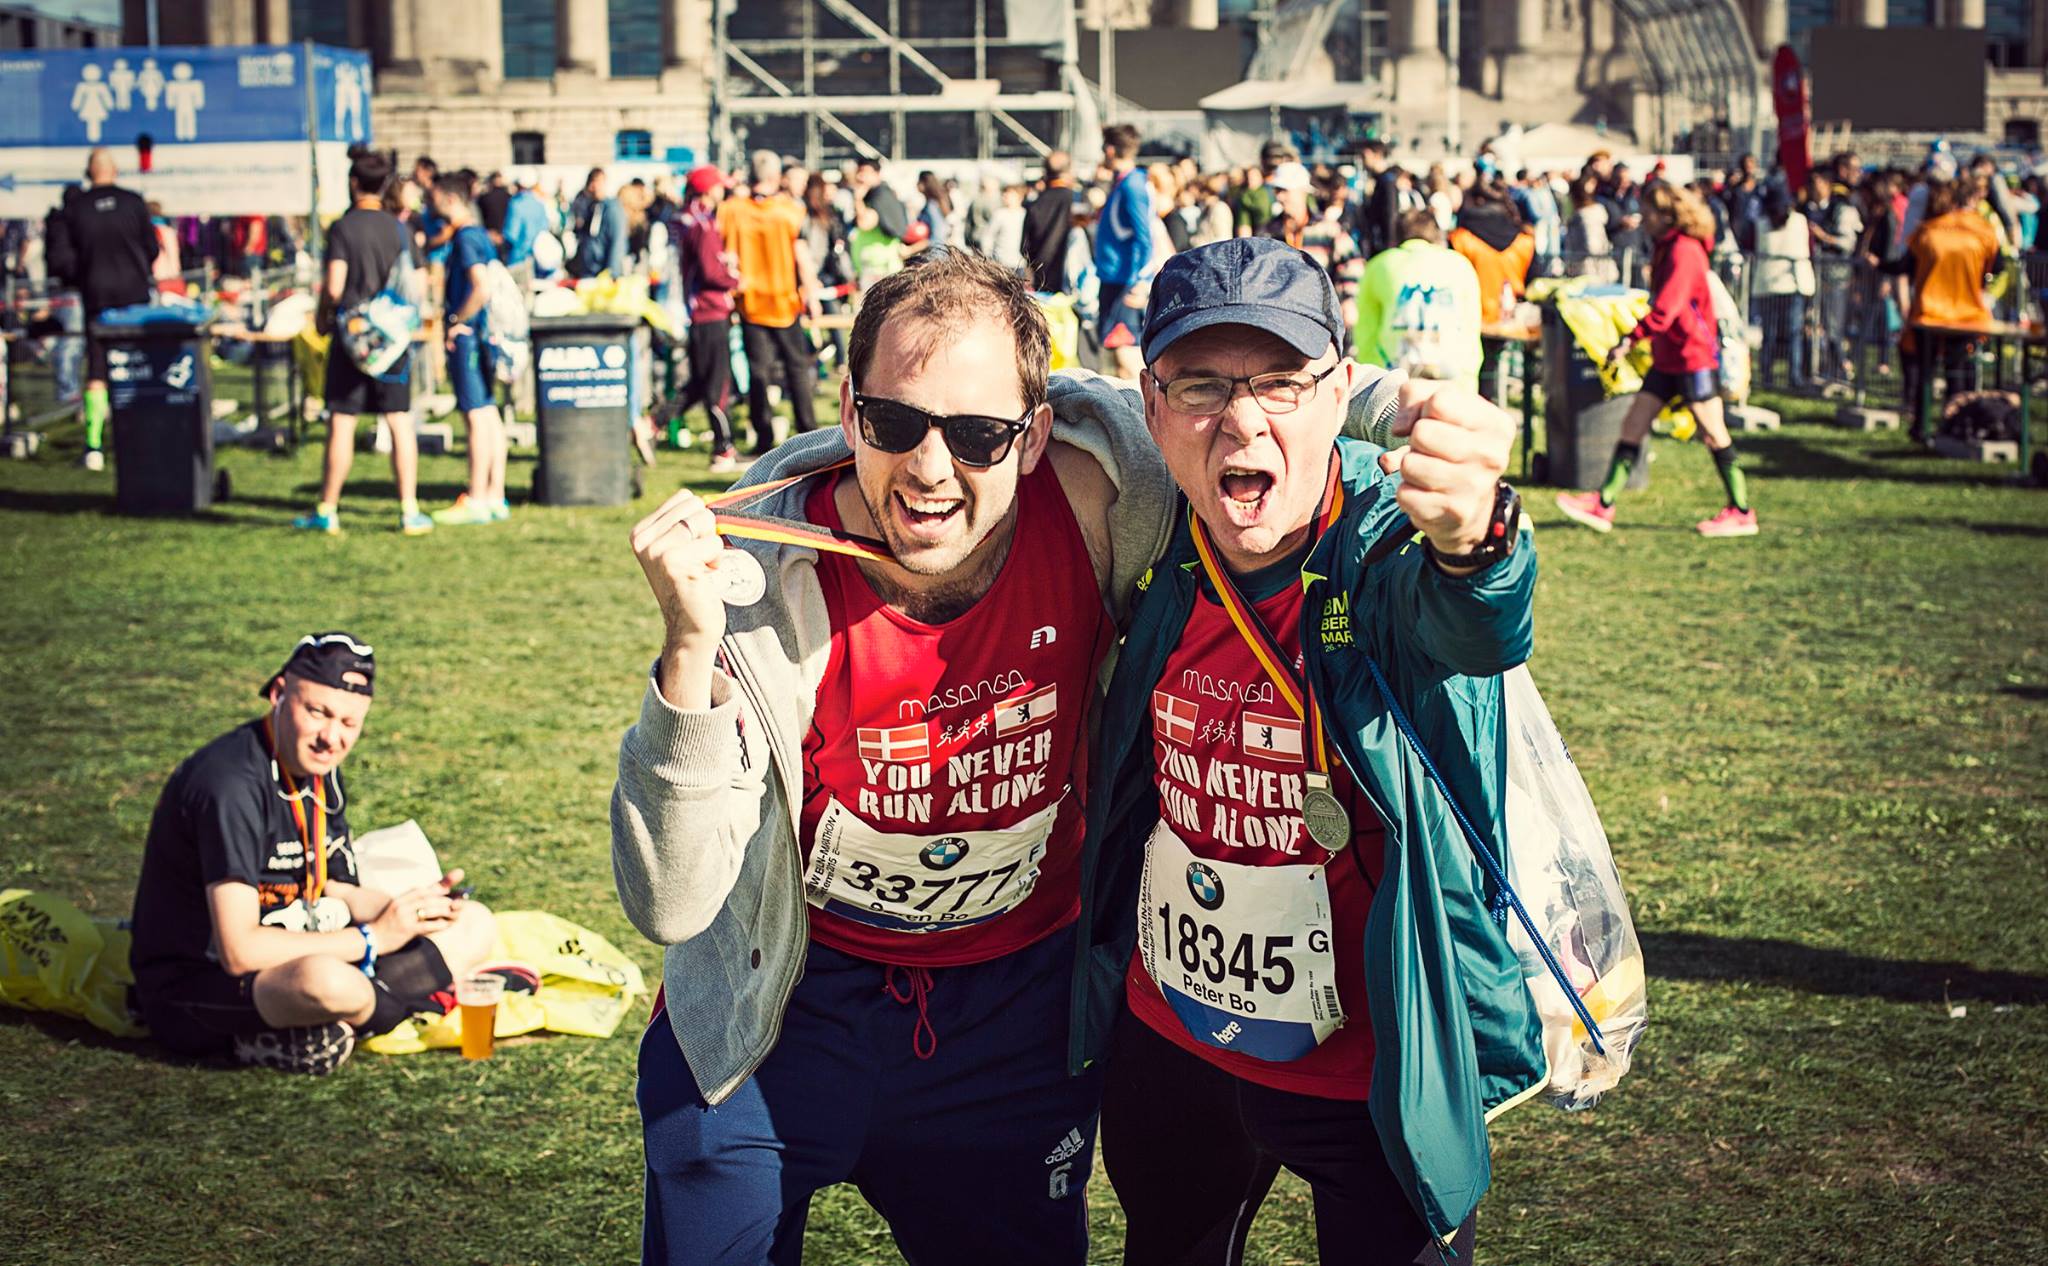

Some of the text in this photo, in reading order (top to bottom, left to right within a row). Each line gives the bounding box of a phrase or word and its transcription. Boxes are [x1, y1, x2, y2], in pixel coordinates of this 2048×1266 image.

[899, 669, 1027, 720] MASANGA
[861, 728, 1052, 792] YOU NEVER
[1205, 757, 1304, 811] NEVER
[858, 763, 1048, 824] RUN ALONE
[1028, 843, 1041, 863] F
[1212, 803, 1305, 856] ALONE
[841, 859, 1022, 912] 33777
[1188, 863, 1220, 884] BMW
[1158, 901, 1295, 995] 18345
[1308, 929, 1330, 953] G
[1183, 973, 1257, 1014] Peter Bo
[1212, 1020, 1242, 1044] here
